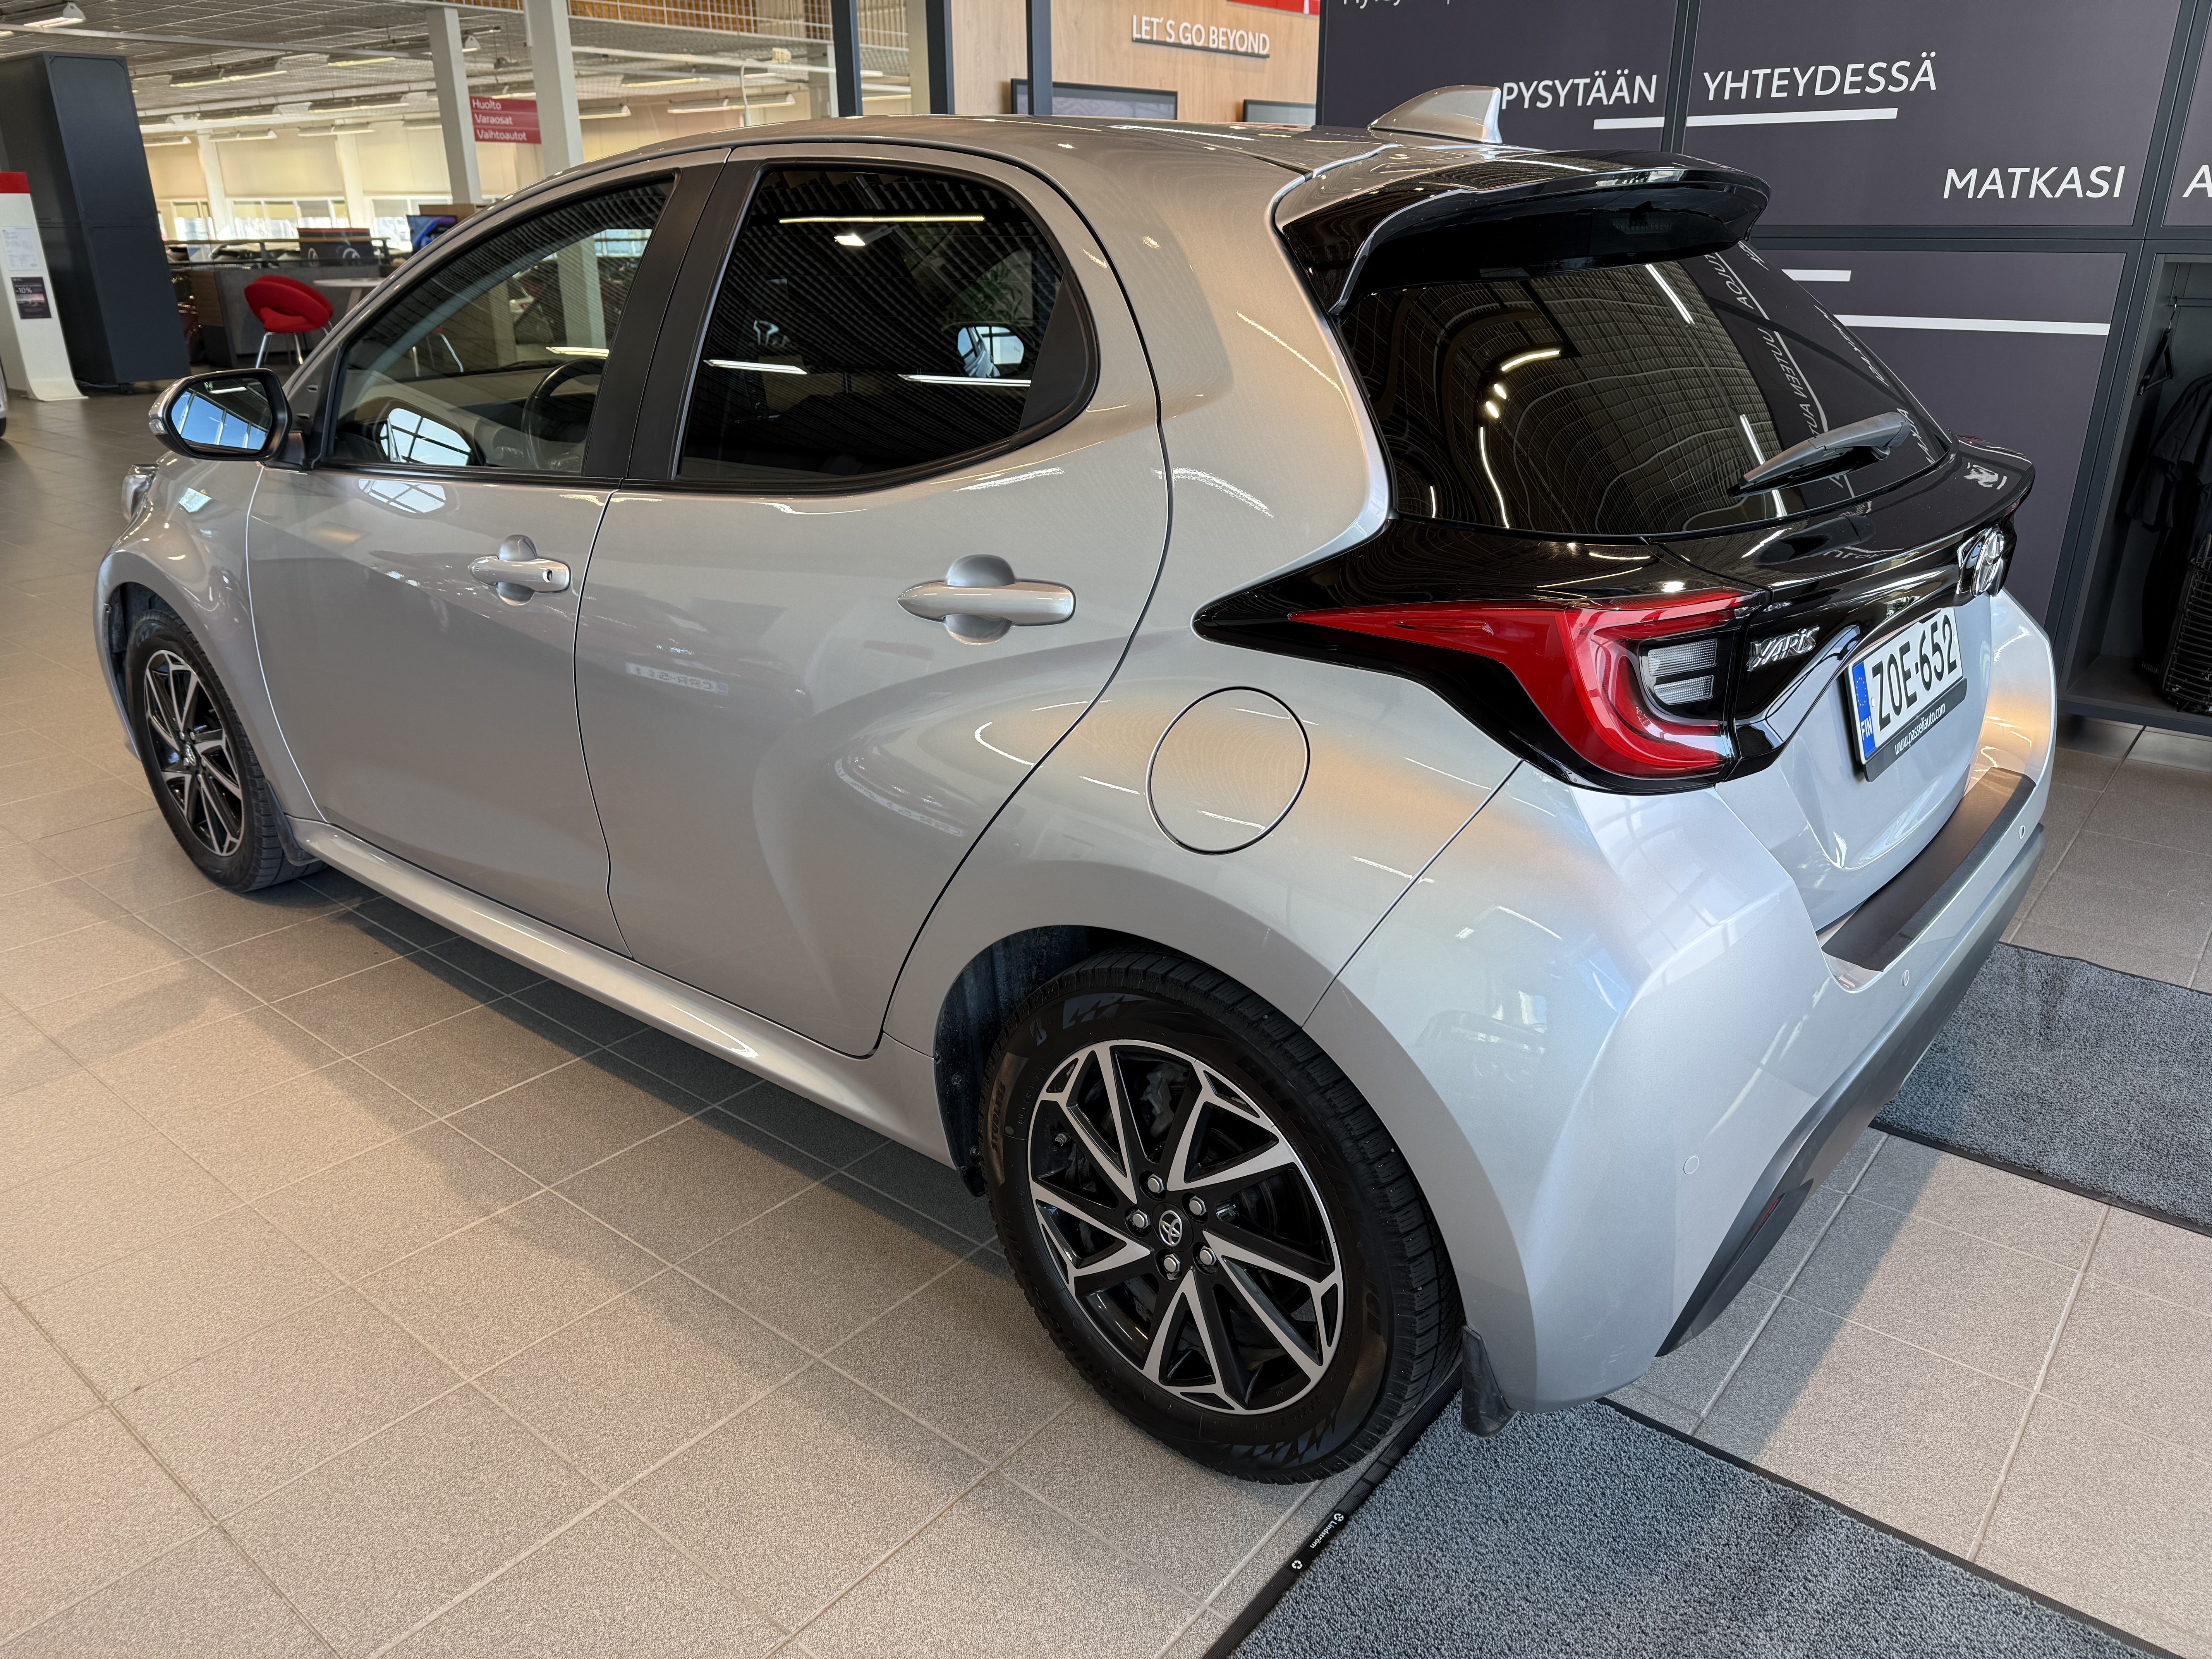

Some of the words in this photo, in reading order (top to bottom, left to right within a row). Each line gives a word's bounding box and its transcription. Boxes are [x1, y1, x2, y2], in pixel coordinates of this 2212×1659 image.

[1178, 22, 1206, 47] GO
[1209, 26, 1270, 55] BEYOND
[1501, 69, 1657, 110] PYSYTÄÄN
[1703, 51, 1936, 101] YHTEYDESSÄ
[472, 99, 502, 110] Huolto
[474, 113, 514, 125] Varaosat
[476, 129, 527, 141] Vaihtoautot
[1942, 165, 2126, 199] MATKASI
[1871, 614, 1958, 732] ZOE-652
[1860, 715, 1873, 741] FIN
[1894, 702, 1946, 755] www.passeliauto.com
[990, 1080, 1007, 1152] STUDLESS
[1310, 1520, 1337, 1548] Lindström
